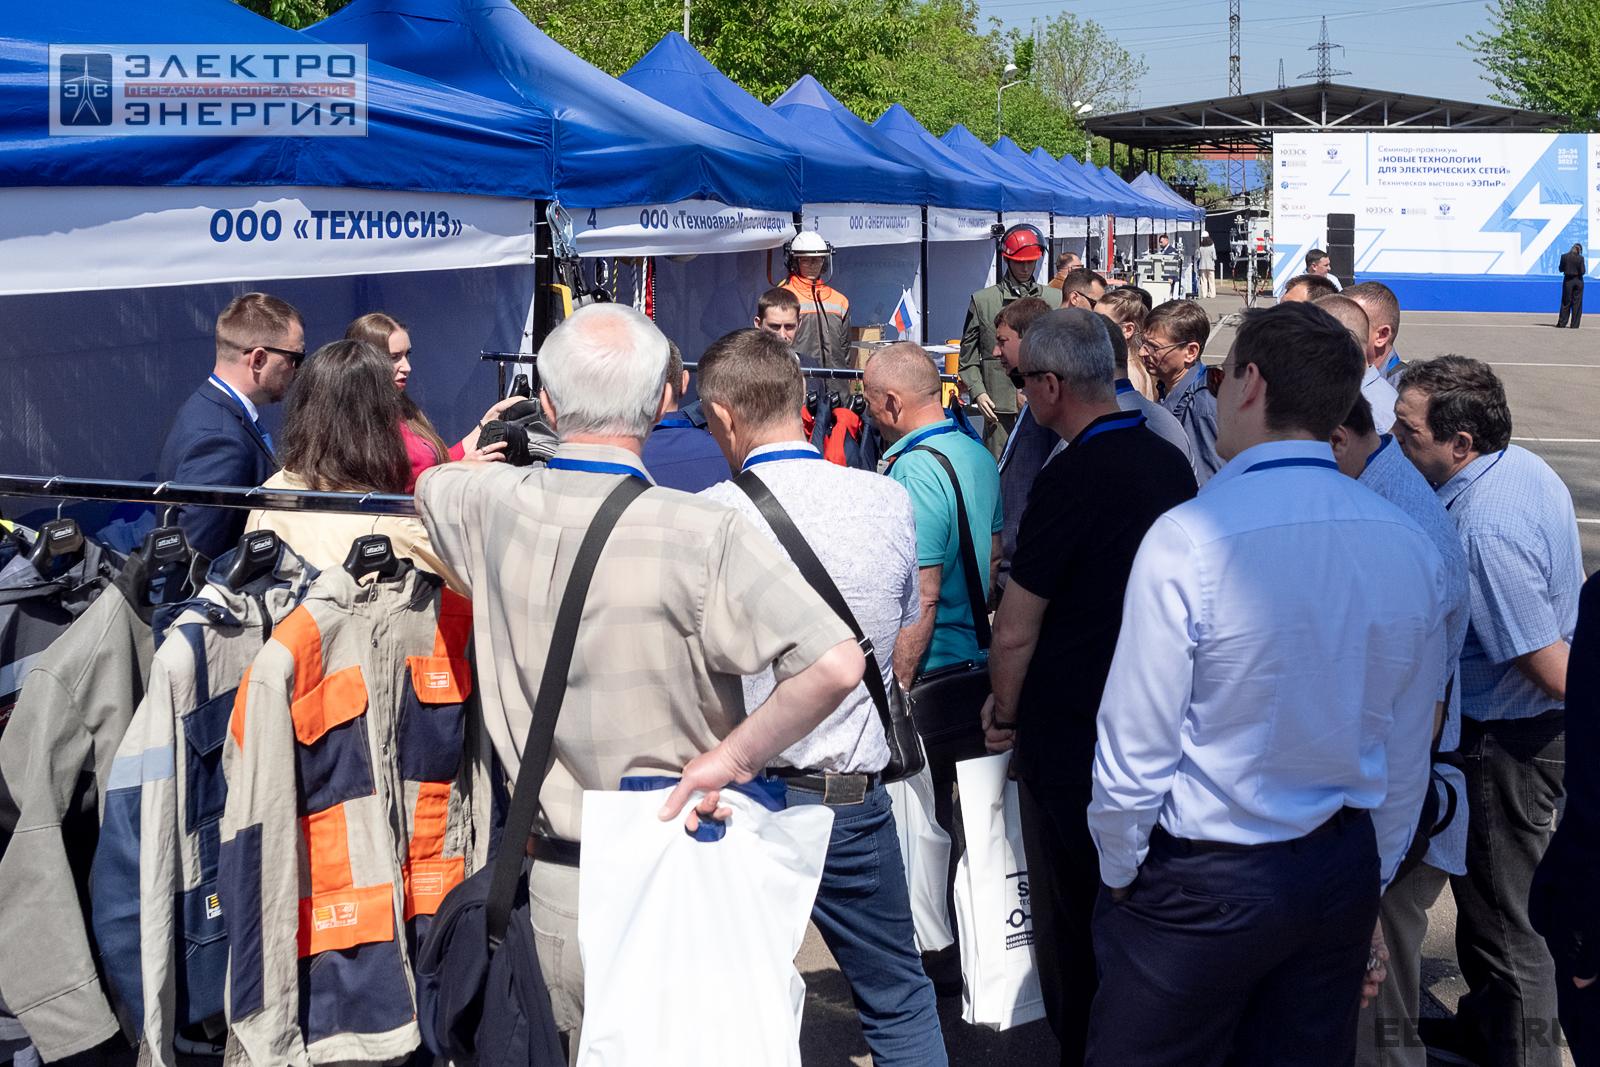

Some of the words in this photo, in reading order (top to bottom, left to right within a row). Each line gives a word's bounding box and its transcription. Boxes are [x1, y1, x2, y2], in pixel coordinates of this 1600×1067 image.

[1378, 155, 1416, 164] «НОВЫЕ
[1418, 156, 1482, 164] ТЕХНОЛОГИИ
[1377, 166, 1397, 174] ДЛЯ
[1400, 166, 1477, 174] ЭЛЕКТРИЧЕСКИХ
[1478, 165, 1511, 175] СЕТЕЙ»
[210, 209, 282, 243] ООО
[293, 209, 463, 241] «ТЕХНОСИЗ»
[587, 207, 598, 230] 4
[640, 208, 669, 230] ООО
[814, 215, 819, 231] 5
[849, 215, 864, 230] ООО
